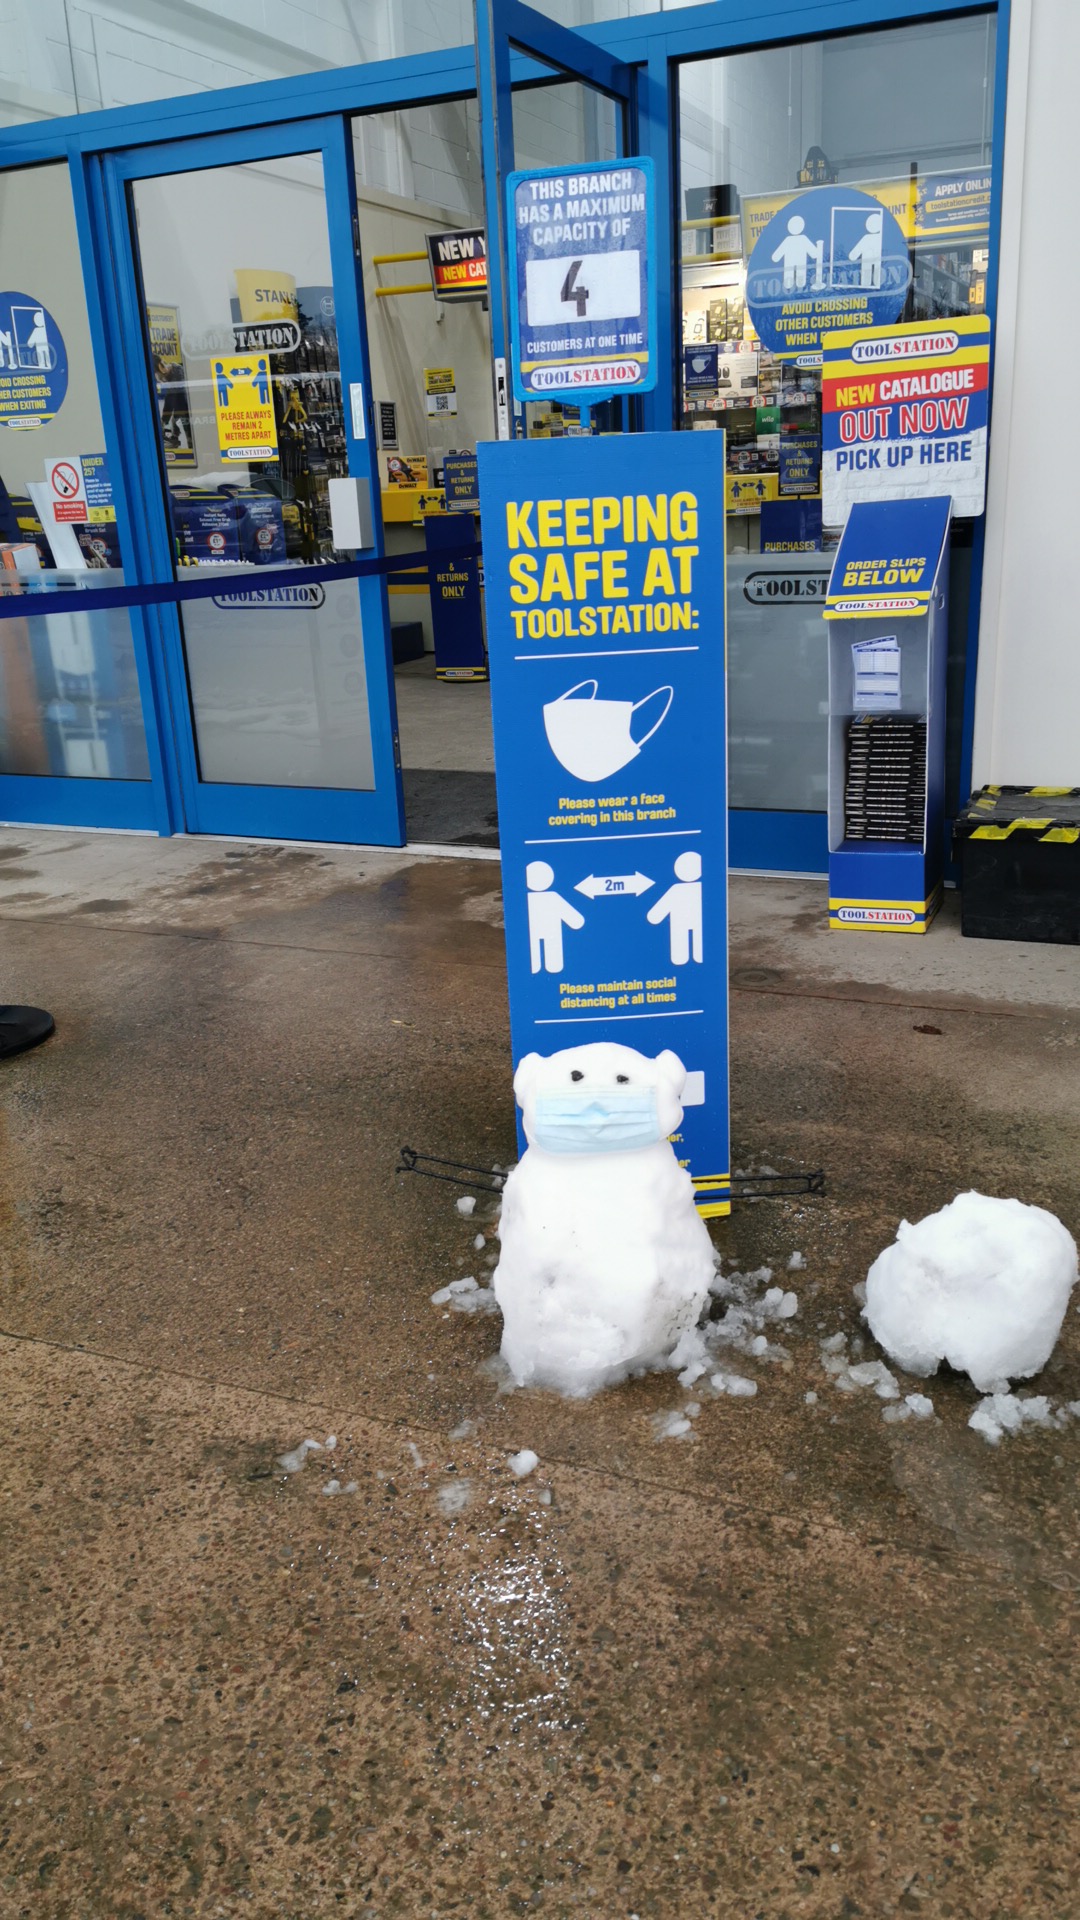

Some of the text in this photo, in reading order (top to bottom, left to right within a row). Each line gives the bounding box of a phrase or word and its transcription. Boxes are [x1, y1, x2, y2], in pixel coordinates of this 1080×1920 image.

[530, 172, 632, 200] THIS BRANCH
[935, 177, 992, 197] APPLY ONLIN
[519, 194, 645, 224] HAS A MAXIMUM
[931, 195, 991, 210] toolstationcredit.c
[750, 211, 775, 223] TRADE
[533, 218, 631, 246] CAPACITY OF
[438, 238, 474, 261] NEW
[443, 262, 487, 281] NEW CAT
[560, 260, 589, 317] 4
[782, 297, 868, 316] AVOID CROSSING
[775, 312, 873, 332] OTHER CUSTOMERS
[151, 327, 176, 341] TRADE
[189, 326, 295, 353] TOOLSTATION
[786, 332, 817, 346] WHEN
[527, 332, 643, 354] CUSTOMERS AT ONE TIME
[855, 336, 955, 358] TOOLSTATION
[13, 375, 46, 386] CROSSING
[534, 365, 637, 386] TOOLSTATION
[12, 387, 52, 398] CUSTOMERS
[836, 368, 974, 407] NEW CATALOGUE
[20, 399, 47, 410] EXITING
[221, 410, 272, 421] PLEASE ALWAYS
[840, 396, 969, 443] OUT NOW
[232, 421, 263, 431] REMAIN 2
[225, 430, 271, 441] METRES APART
[782, 440, 818, 450] PURCHASES
[229, 449, 271, 457] TOOLSTATION
[836, 440, 972, 471] PICK UP HERE
[82, 457, 104, 467] UNDER
[446, 461, 477, 470] PURCHASES
[785, 458, 813, 466] RETURNS
[84, 467, 95, 477] 25?
[789, 468, 810, 478] ONLY
[450, 476, 475, 485] RETURNS
[454, 486, 472, 495] ONLY
[63, 502, 84, 510] smoking
[506, 491, 698, 549] KEEPING
[764, 541, 816, 551] PURCHASES
[449, 563, 454, 572] &
[846, 557, 926, 570] ORDER SLIPS
[437, 573, 469, 582] RETURNS
[509, 545, 699, 604] SAFE AT
[842, 568, 924, 587] BELOW
[442, 586, 465, 597] ONLY
[838, 599, 916, 609] TOOLSTATION
[510, 601, 699, 639] TOOLSTATION:
[559, 793, 665, 809] Please wear a face
[548, 807, 676, 826] covering in this branch
[605, 879, 625, 891] 2m
[841, 910, 913, 921] TOOLSTATION
[560, 976, 677, 994] Please maintain social
[560, 991, 677, 1009] distancing at all times
